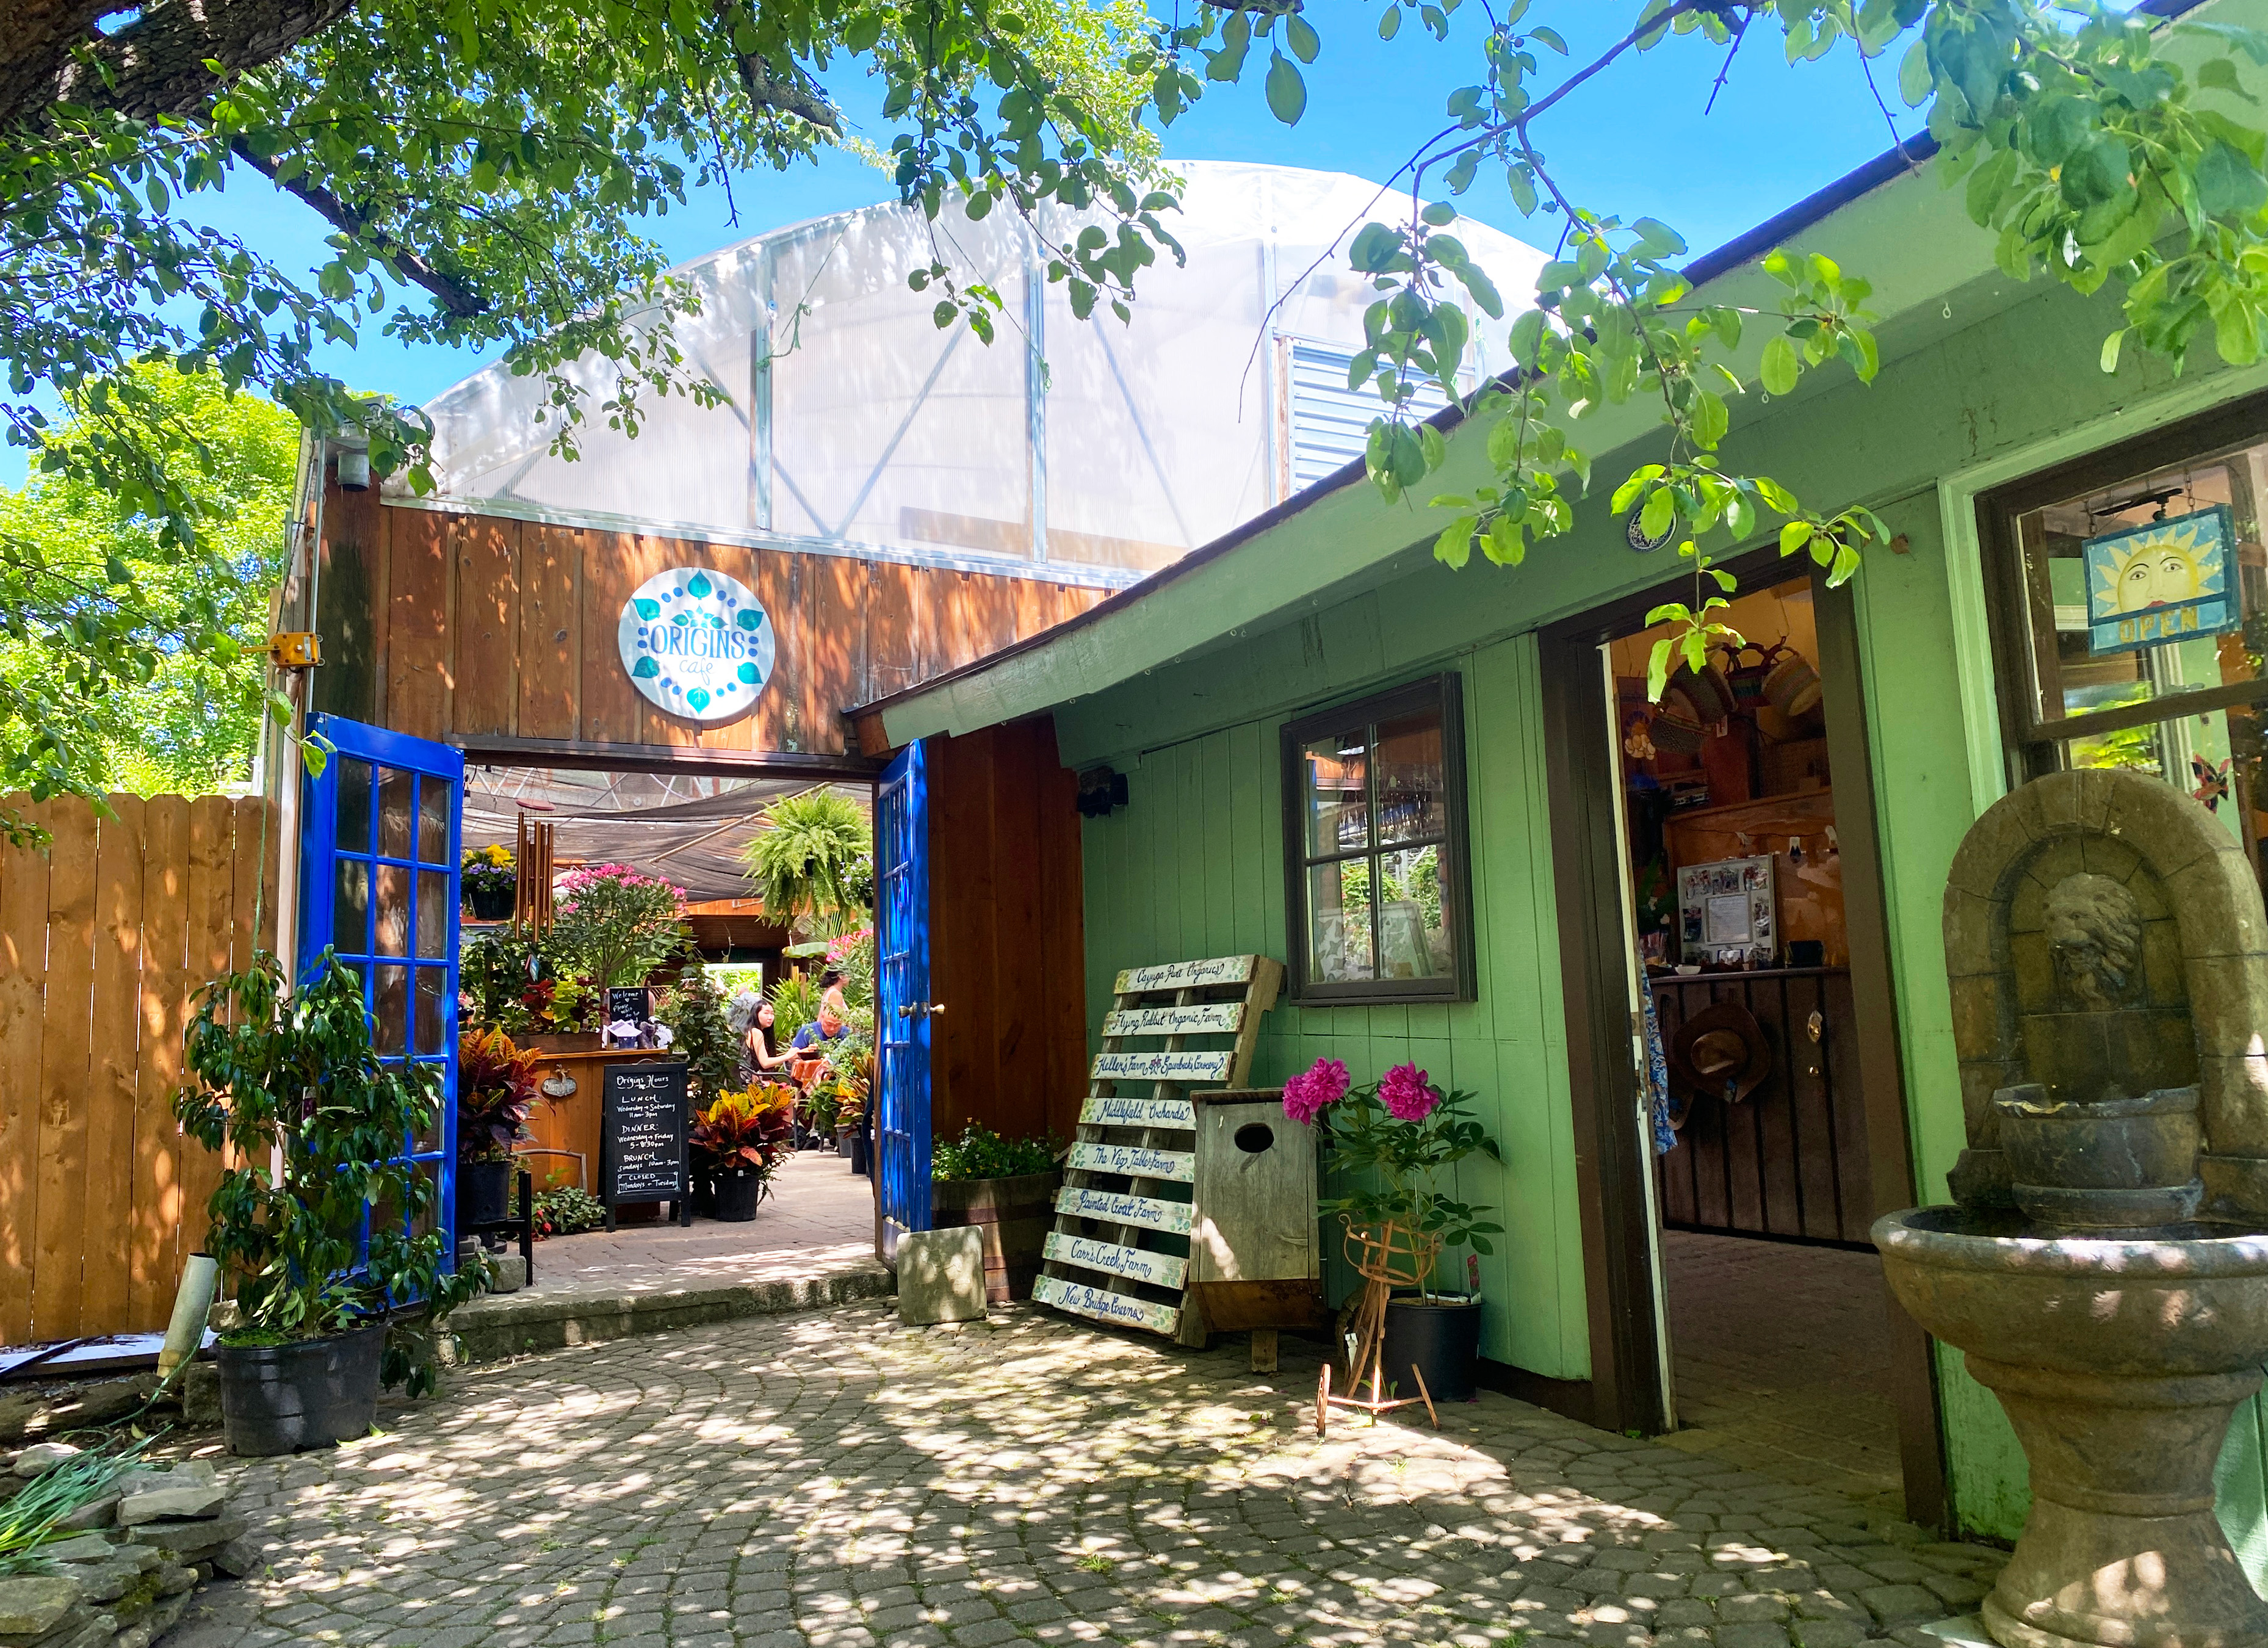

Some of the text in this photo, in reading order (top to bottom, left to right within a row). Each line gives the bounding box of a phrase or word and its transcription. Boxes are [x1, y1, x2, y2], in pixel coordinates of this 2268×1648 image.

[2120, 607, 2199, 643] OPEN
[651, 625, 745, 659] ORIGINS
[1137, 963, 1224, 989] Cayuga Pure Organics
[1112, 1007, 1226, 1035] Flying Rabbit Organic Farm
[1096, 1055, 1224, 1079] Heller's Farm Spurbeck's Grocery
[616, 1074, 669, 1089] Origins Hours
[649, 1104, 675, 1112] Saturday
[1097, 1100, 1191, 1124] Middlefield Orchards
[617, 1133, 674, 1143] Wednesday Friday
[617, 1163, 643, 1172] Sundays
[623, 1151, 658, 1163] BRUNCH
[1093, 1147, 1108, 1164] The
[1110, 1147, 1128, 1173] Veg
[1148, 1150, 1175, 1173] Farm
[1078, 1190, 1163, 1222] Painted Goat Farm
[1071, 1240, 1152, 1278] Carr's Creek Farm
[1058, 1285, 1144, 1321] New Bridge Greens
